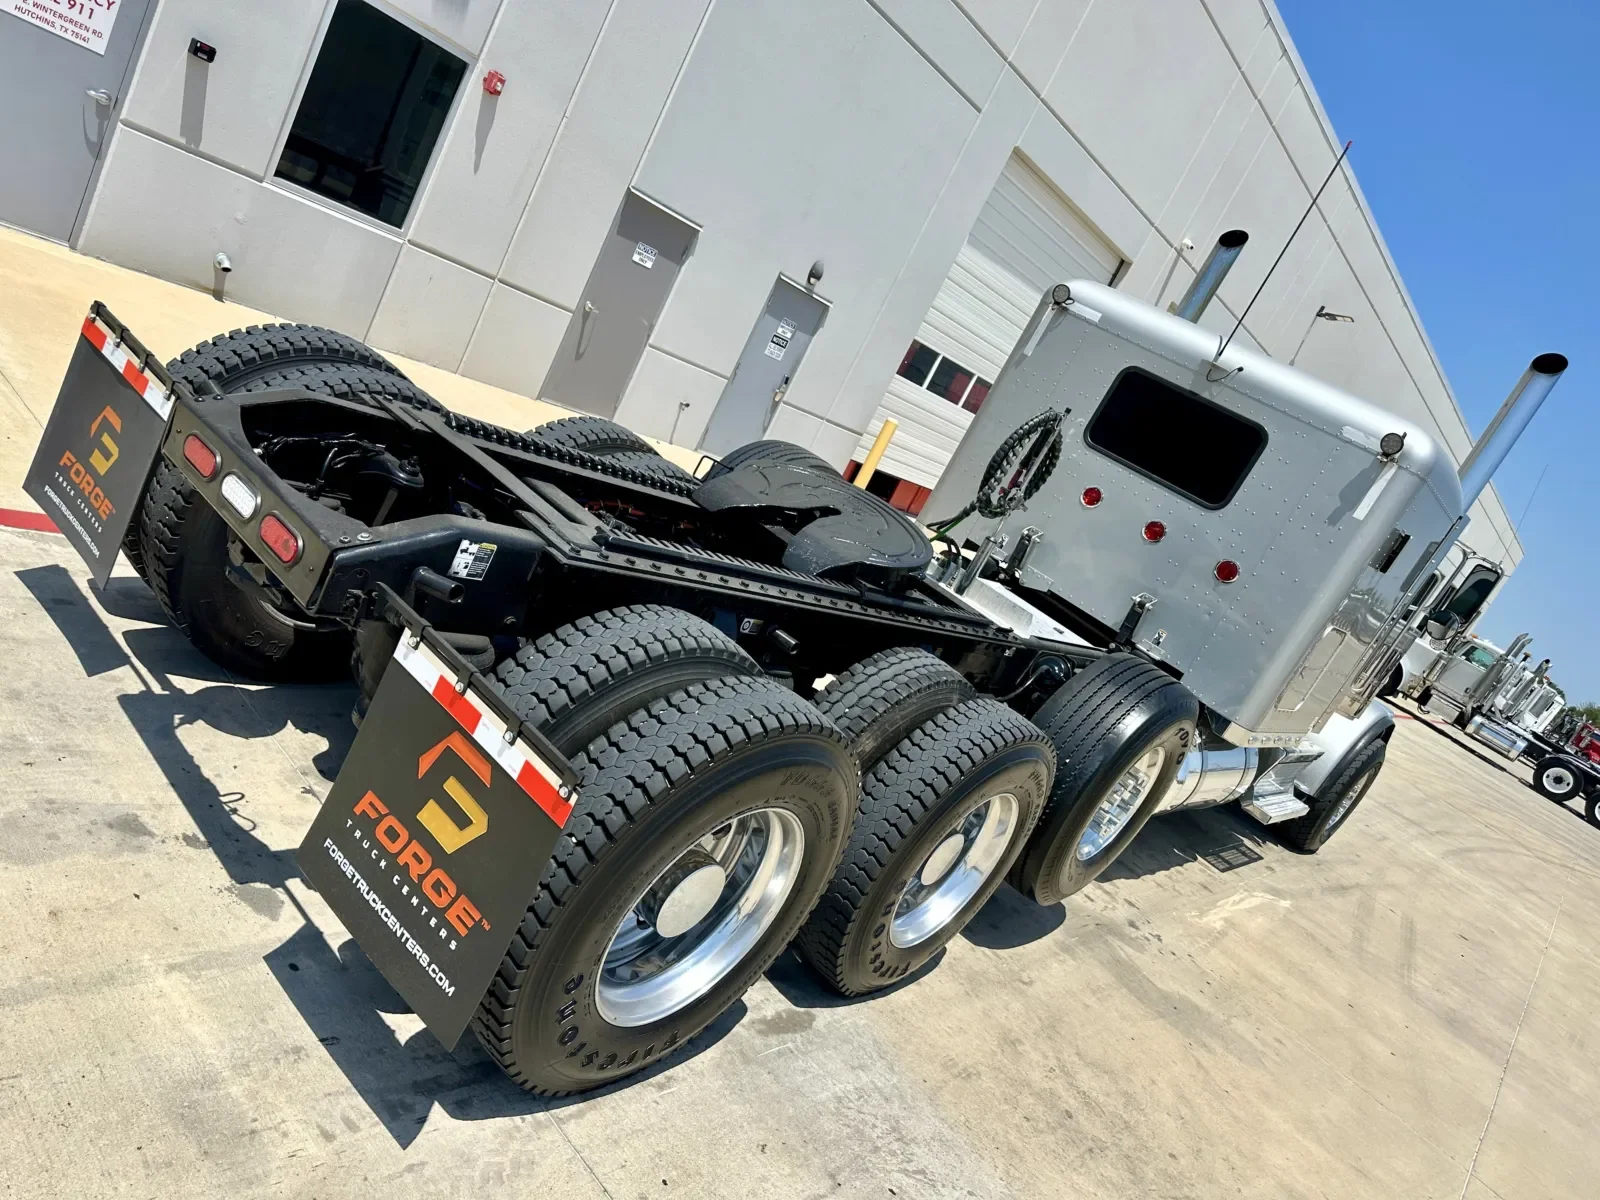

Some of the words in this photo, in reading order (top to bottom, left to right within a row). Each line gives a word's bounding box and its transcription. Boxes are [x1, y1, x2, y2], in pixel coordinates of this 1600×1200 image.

[14, 4, 57, 30] HUTCHINS,
[59, 24, 69, 35] TX
[71, 29, 90, 44] 75141
[32, 0, 91, 33] WINTERGREEN
[91, 27, 104, 40] RD.
[67, 0, 94, 20] 911
[772, 335, 787, 349] NOTICE
[54, 471, 74, 497] TRUCK
[77, 498, 102, 533] CENTERS
[59, 450, 114, 521] FORGE
[43, 485, 100, 558] FORGETRUCKCENTERS.COM
[1174, 727, 1189, 765] TOYO
[345, 818, 387, 870] TRUCK
[392, 875, 457, 951] CENTERS
[353, 790, 482, 937] FORGE
[323, 837, 456, 997] FORGETRUCKCENTERS.COM
